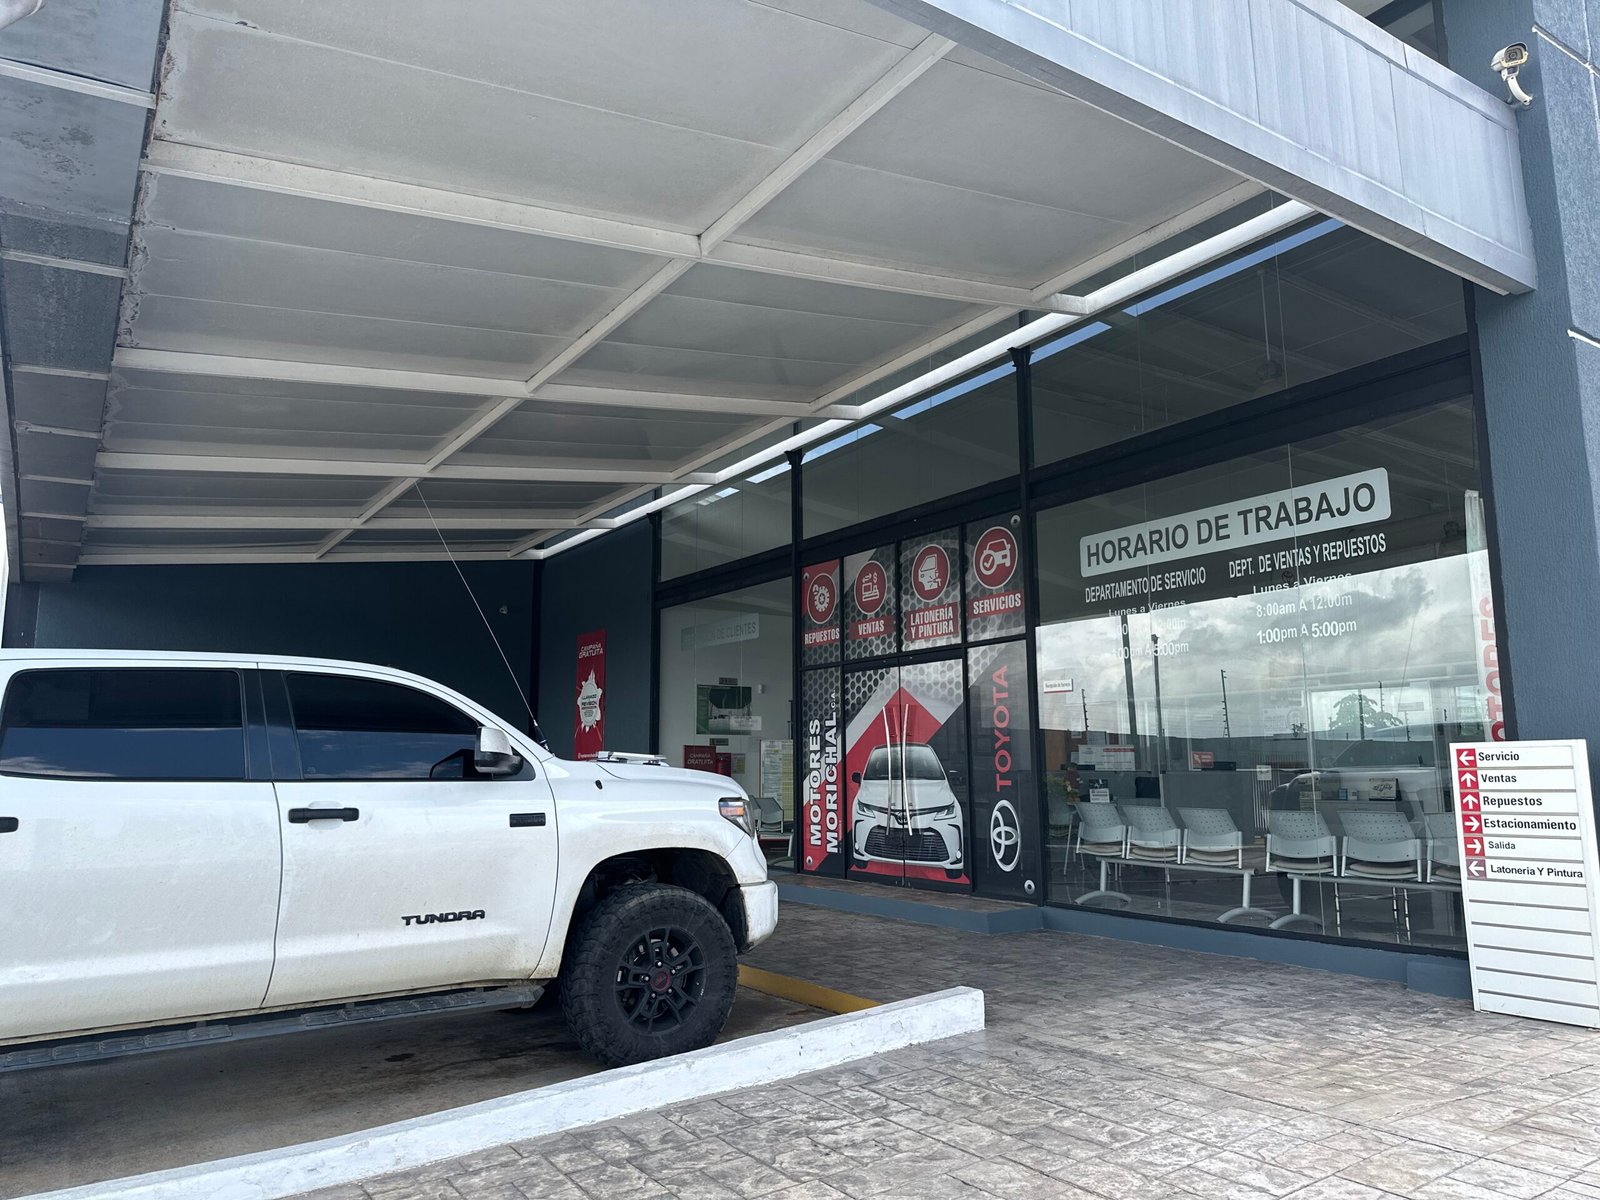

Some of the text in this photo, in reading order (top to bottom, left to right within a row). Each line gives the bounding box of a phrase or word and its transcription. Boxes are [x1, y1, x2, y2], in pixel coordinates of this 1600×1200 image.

[1086, 482, 1376, 567] HORARIO DE TRABAJO
[1229, 533, 1386, 578] DEPT. DE VENTAS Y REPUESTOS
[1085, 566, 1207, 603] DEPARTAMENTO DE SERVICIO
[1253, 583, 1290, 595] Lunes
[1293, 582, 1300, 590] a
[973, 593, 1022, 615] SERVICIOS
[1108, 600, 1186, 617] Lunes a Viernes
[1256, 594, 1353, 618] 8:00am A 12:00m
[910, 604, 953, 626] LATONERÍA
[726, 622, 757, 638] CLIENTES
[858, 619, 885, 635] VENTAS
[911, 620, 954, 638] Y PINTURA
[1256, 620, 1357, 644] 1:00pm A 5:00pm
[804, 628, 840, 645] REPUESTOS
[992, 664, 1012, 793] TOYOTA
[1478, 751, 1520, 762] Servicio
[809, 719, 822, 846] MOTORES
[825, 711, 839, 854] MORICHAL
[1480, 774, 1517, 783] Ventas
[1482, 796, 1543, 808] Repuestos
[1483, 818, 1577, 831] Estacionamiento
[1488, 841, 1516, 850] Salida
[1490, 864, 1584, 878] Latoneria Y Pintura
[401, 909, 486, 926] TUNDRA
